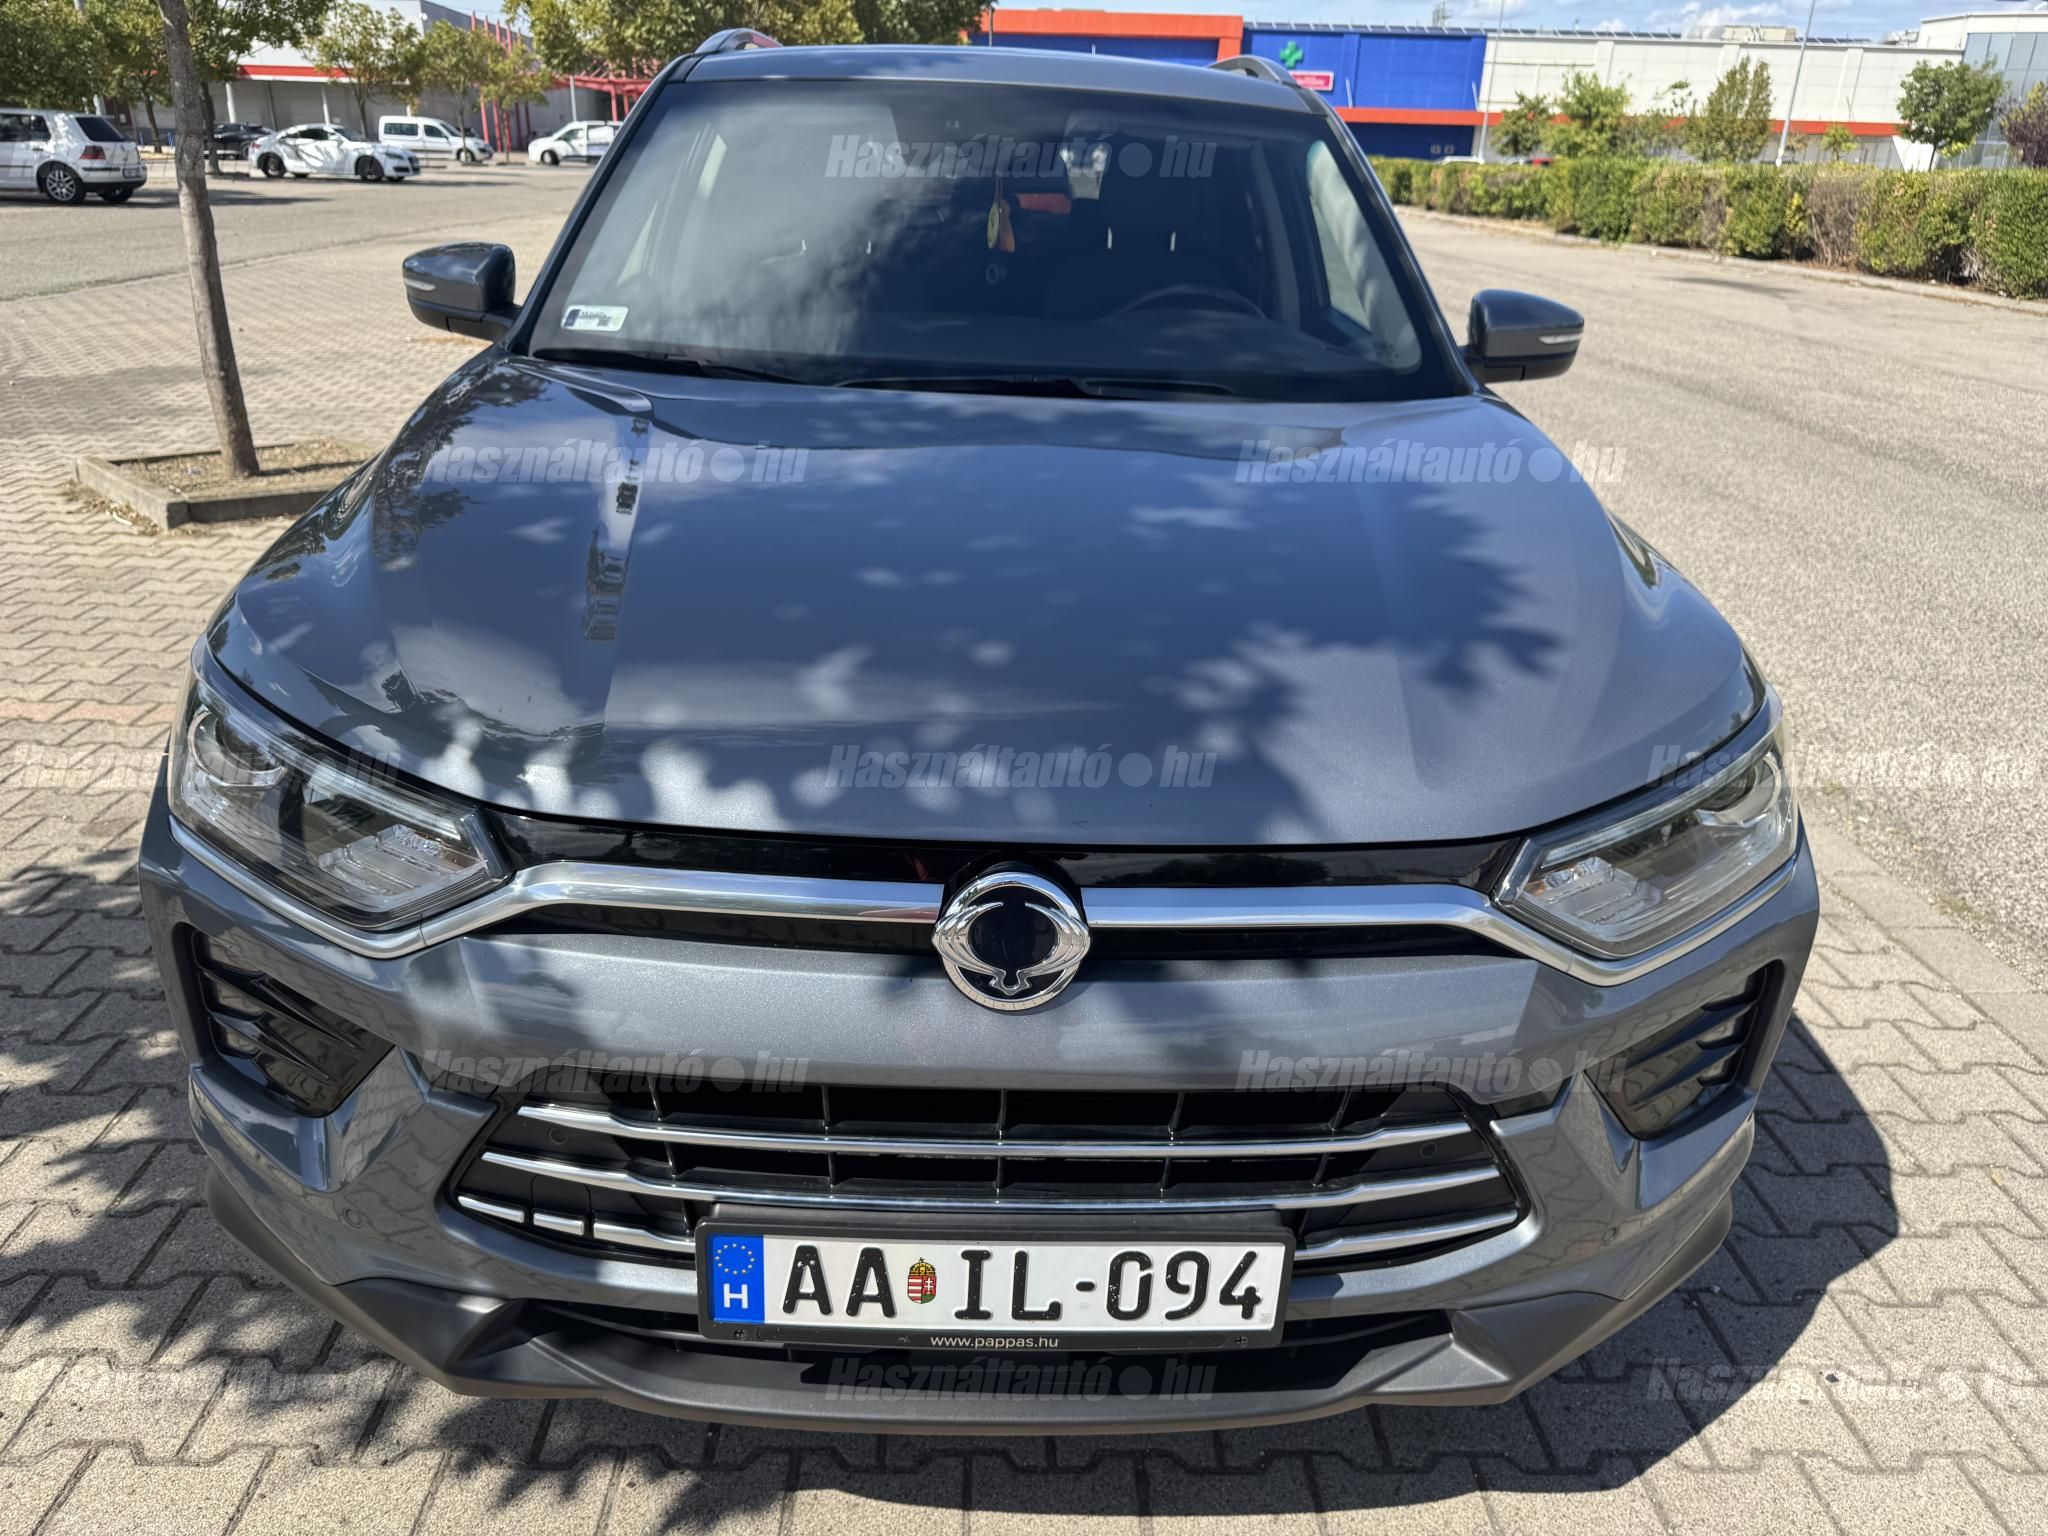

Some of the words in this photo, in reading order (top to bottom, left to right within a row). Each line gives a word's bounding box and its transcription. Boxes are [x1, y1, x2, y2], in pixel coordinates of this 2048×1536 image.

[723, 1283, 749, 1309] H
[954, 1249, 1262, 1321] IL-094
[930, 1336, 1059, 1349] www.pappas.hu
